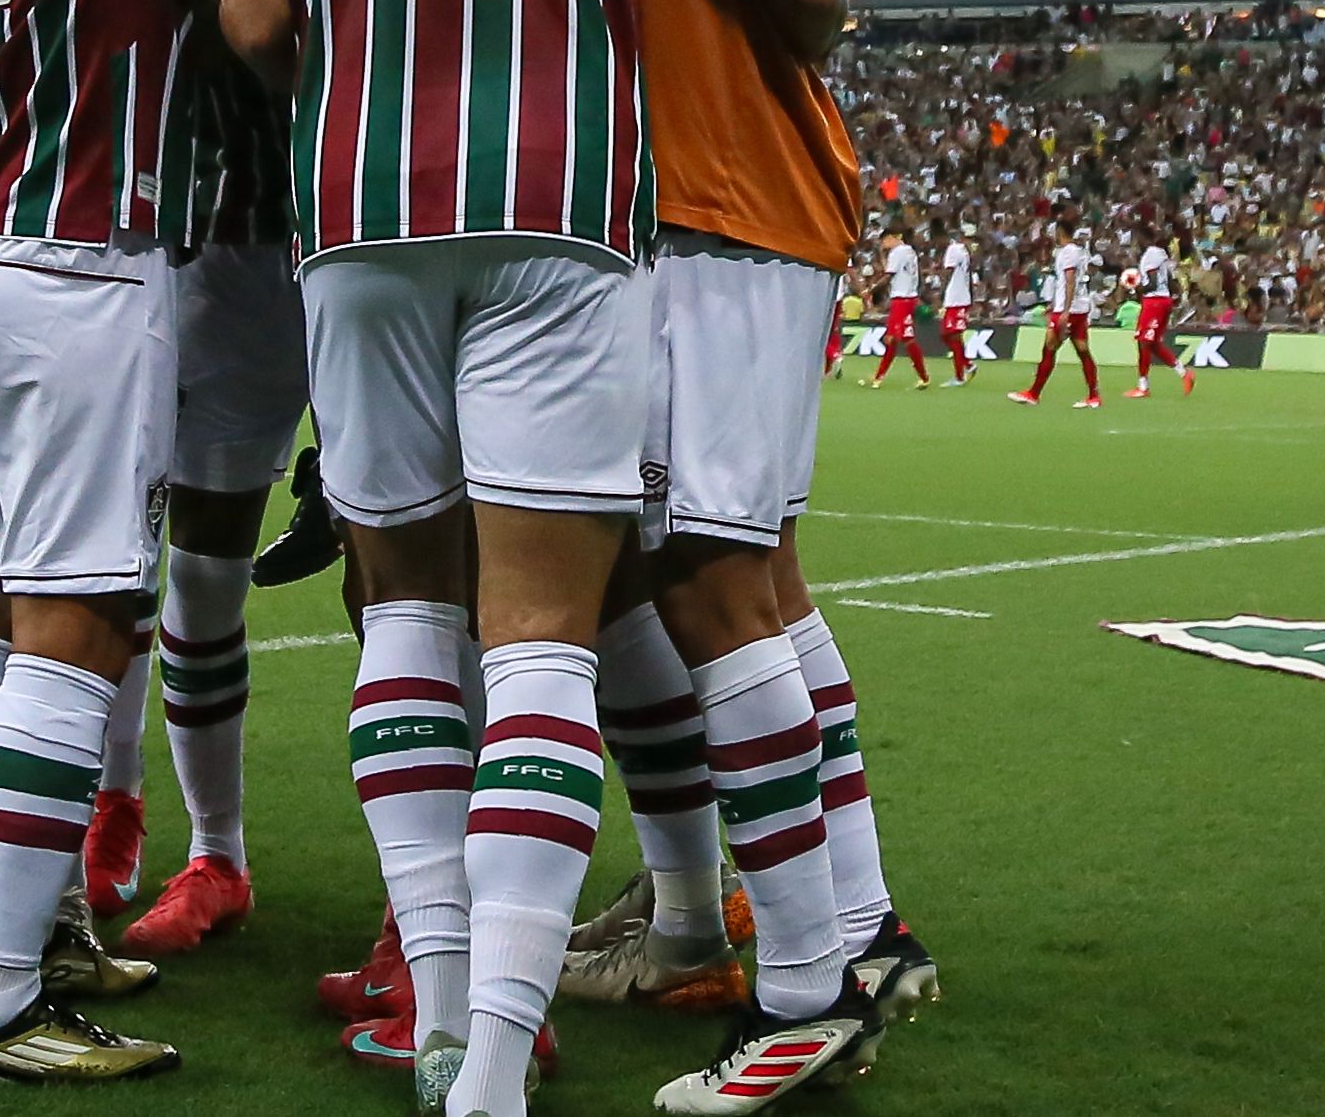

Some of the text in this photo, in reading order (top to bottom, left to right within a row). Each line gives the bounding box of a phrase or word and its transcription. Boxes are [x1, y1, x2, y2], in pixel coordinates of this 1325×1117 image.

[842, 326, 887, 356] 7K
[1175, 335, 1230, 368] 7K
[376, 724, 435, 740] FFC
[502, 764, 564, 781] FFC
